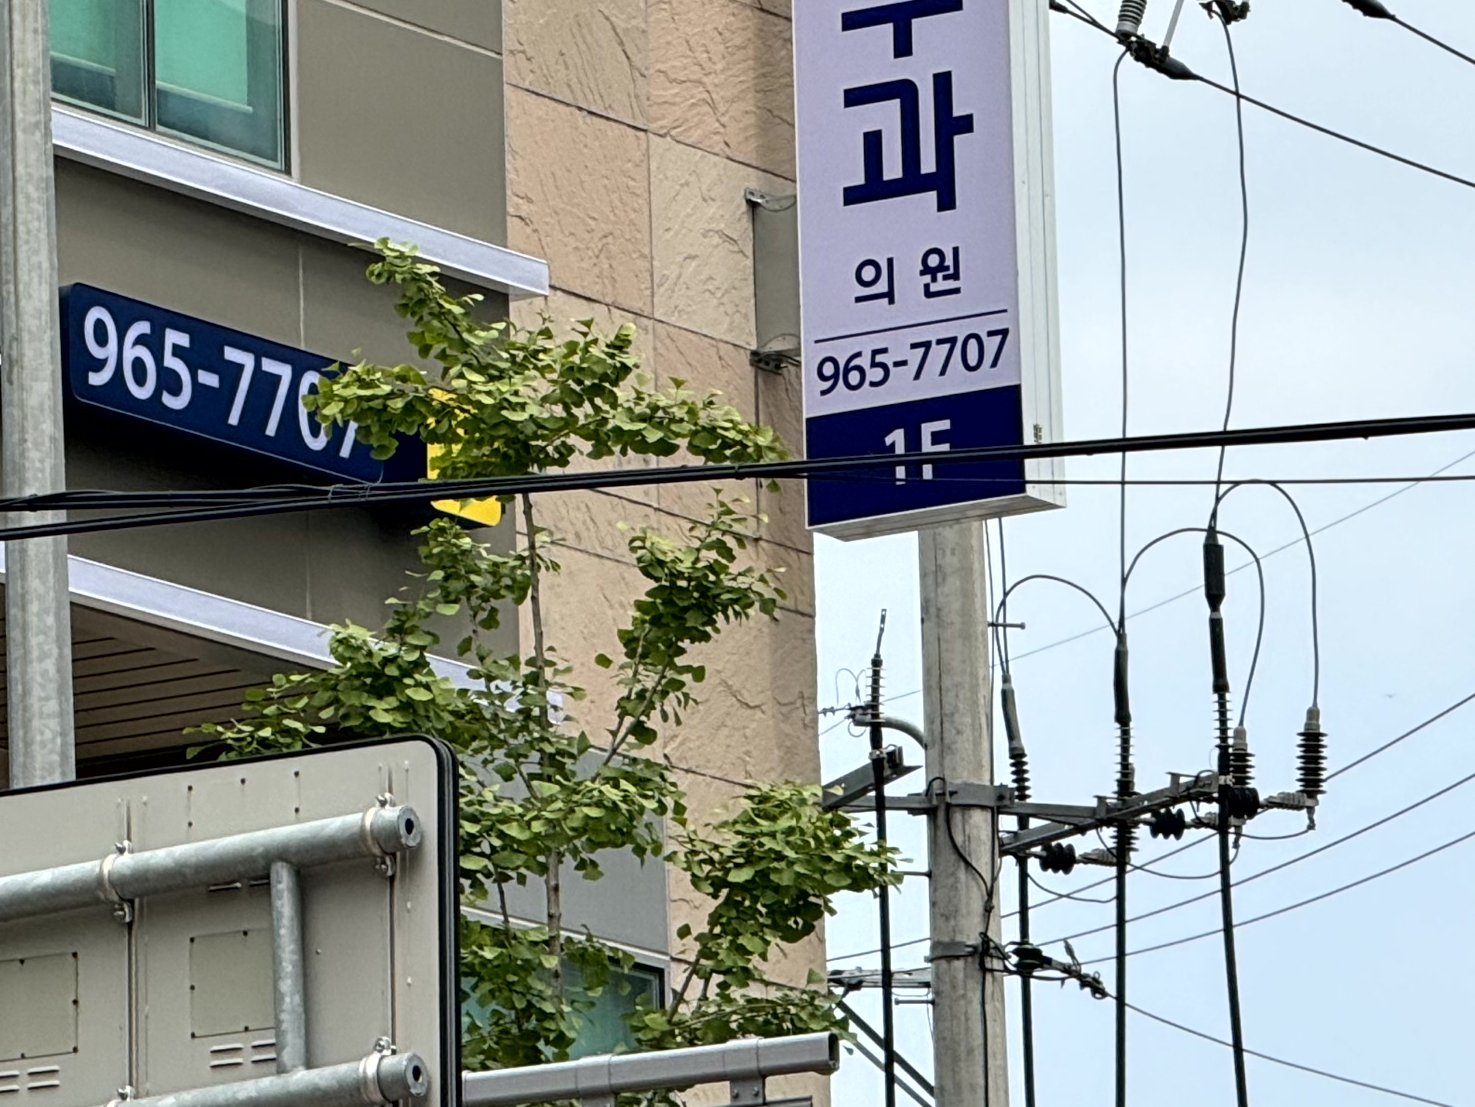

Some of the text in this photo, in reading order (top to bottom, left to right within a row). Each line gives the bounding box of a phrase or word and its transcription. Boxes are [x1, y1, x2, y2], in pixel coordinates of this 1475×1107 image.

[854, 246, 962, 305] 의원
[816, 327, 1010, 397] 965-7707
[884, 419, 951, 485] 1F
